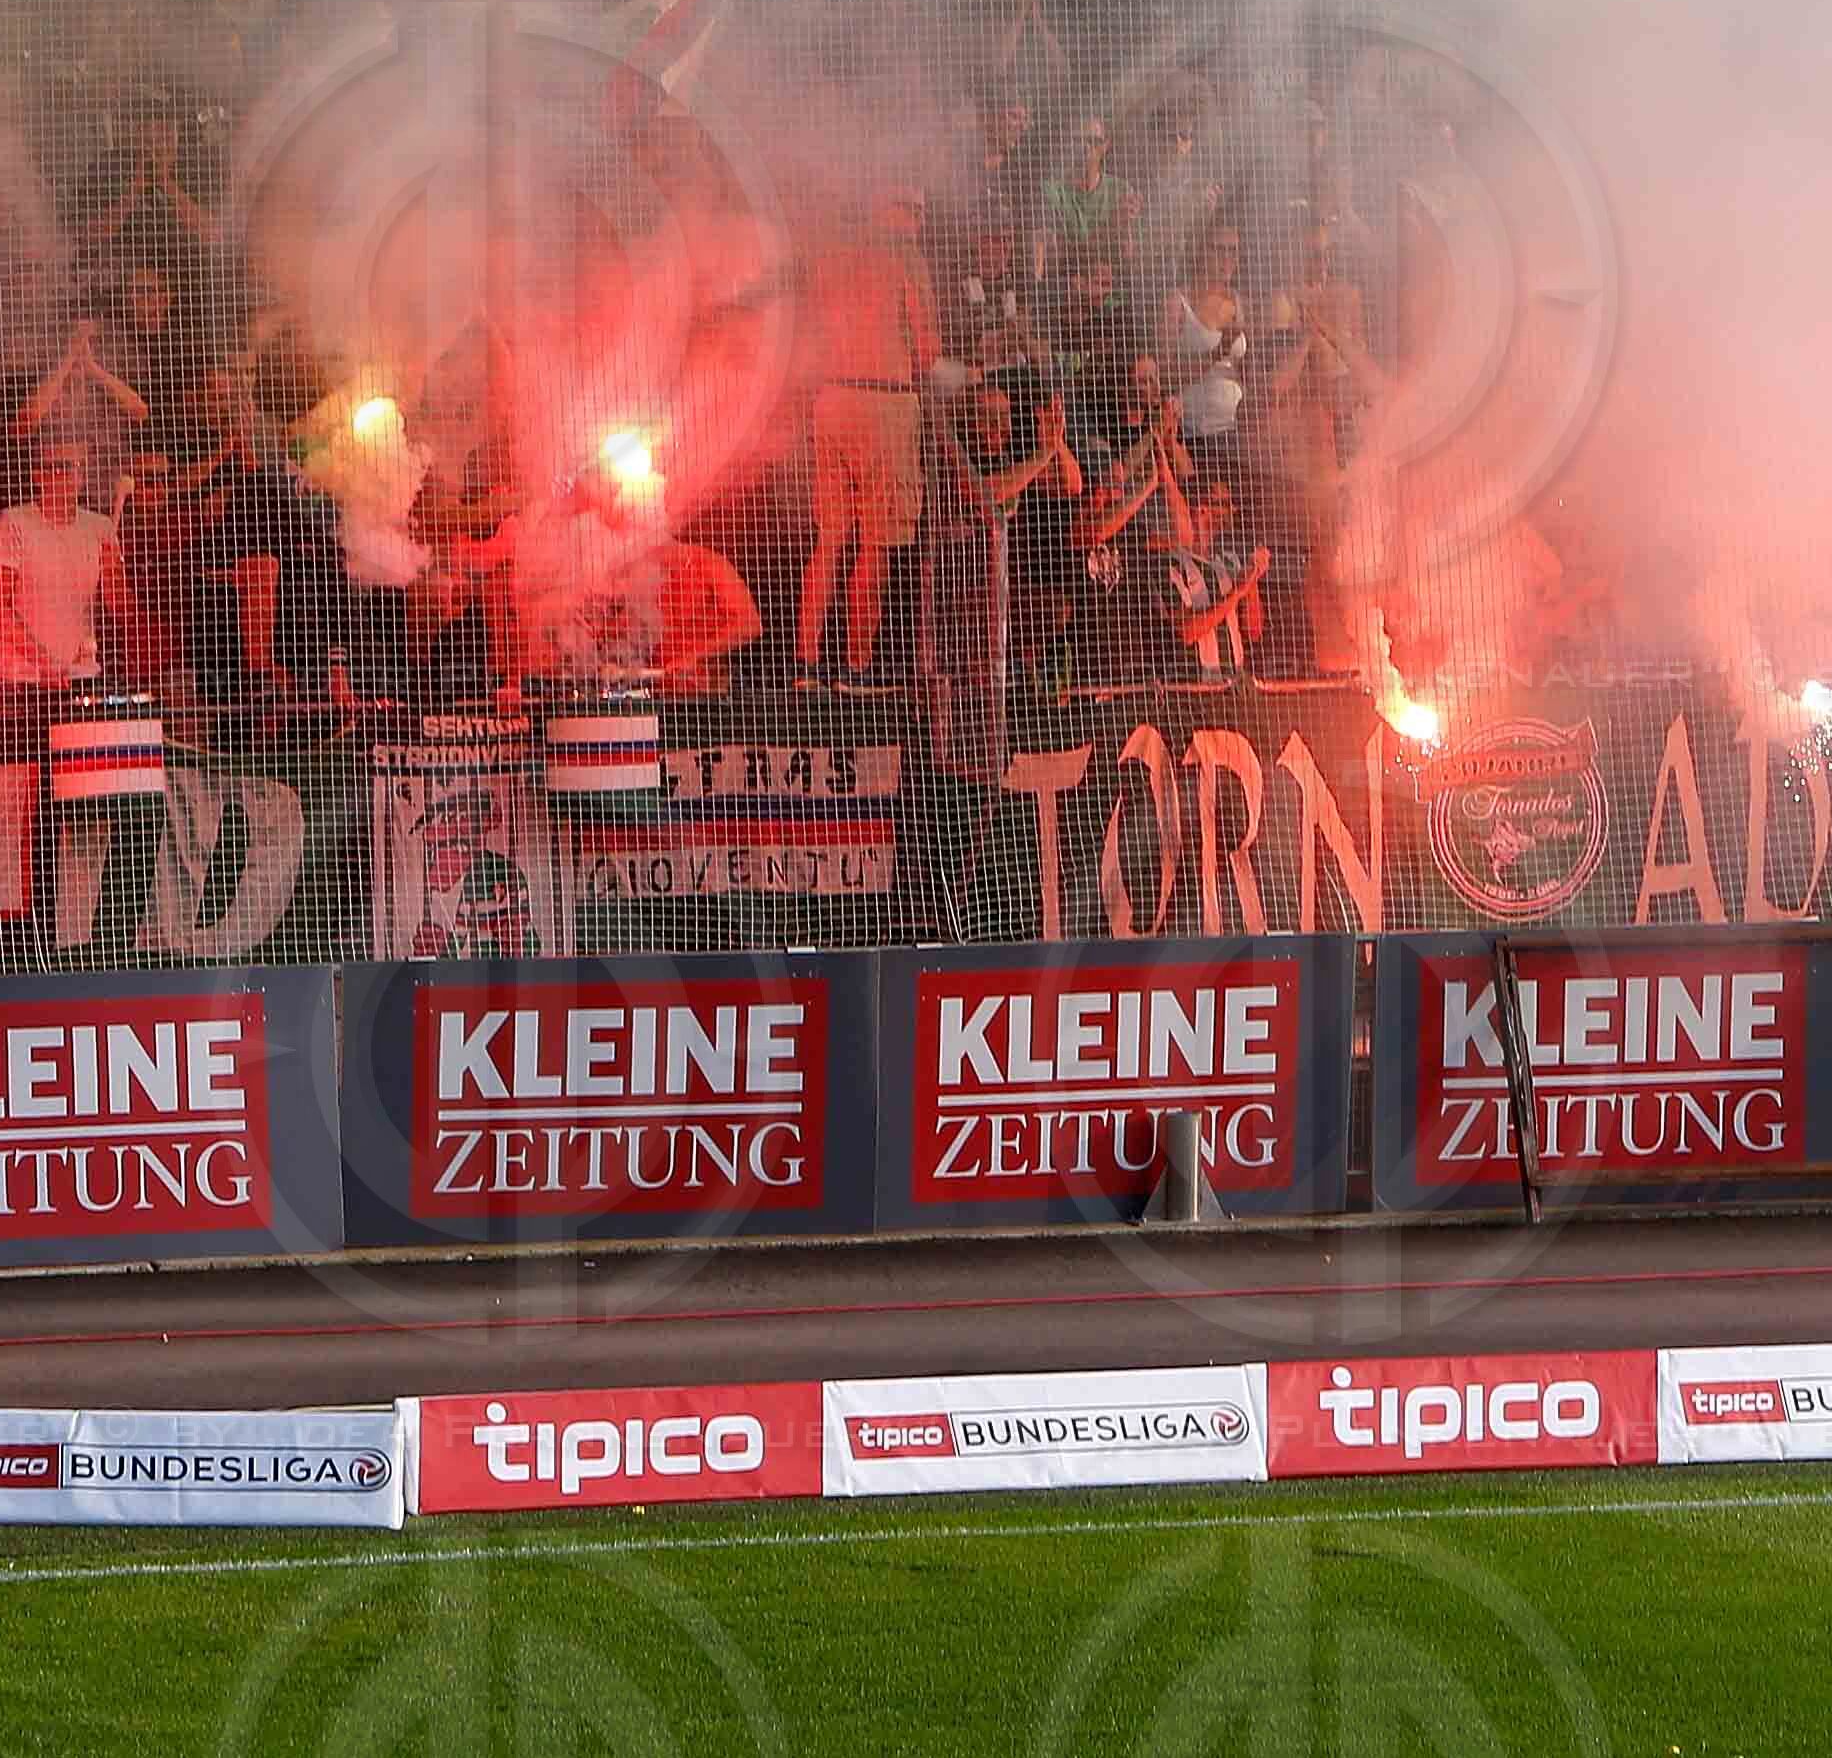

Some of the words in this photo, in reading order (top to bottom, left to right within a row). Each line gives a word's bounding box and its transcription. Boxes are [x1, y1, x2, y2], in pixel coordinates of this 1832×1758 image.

[438, 1005, 804, 1101] KLEINE
[938, 986, 1278, 1085] KLEINE
[1444, 973, 1785, 1069] KLEINE
[433, 1118, 804, 1195] ZEITUNG
[474, 1402, 765, 1495] tipico
[858, 1421, 945, 1456] tipico
[960, 1409, 1207, 1450] BUNDESLIGA
[1319, 1365, 1601, 1460] tipico
[1691, 1385, 1777, 1419] tipico
[69, 1453, 343, 1486] BUNDESLIGA
